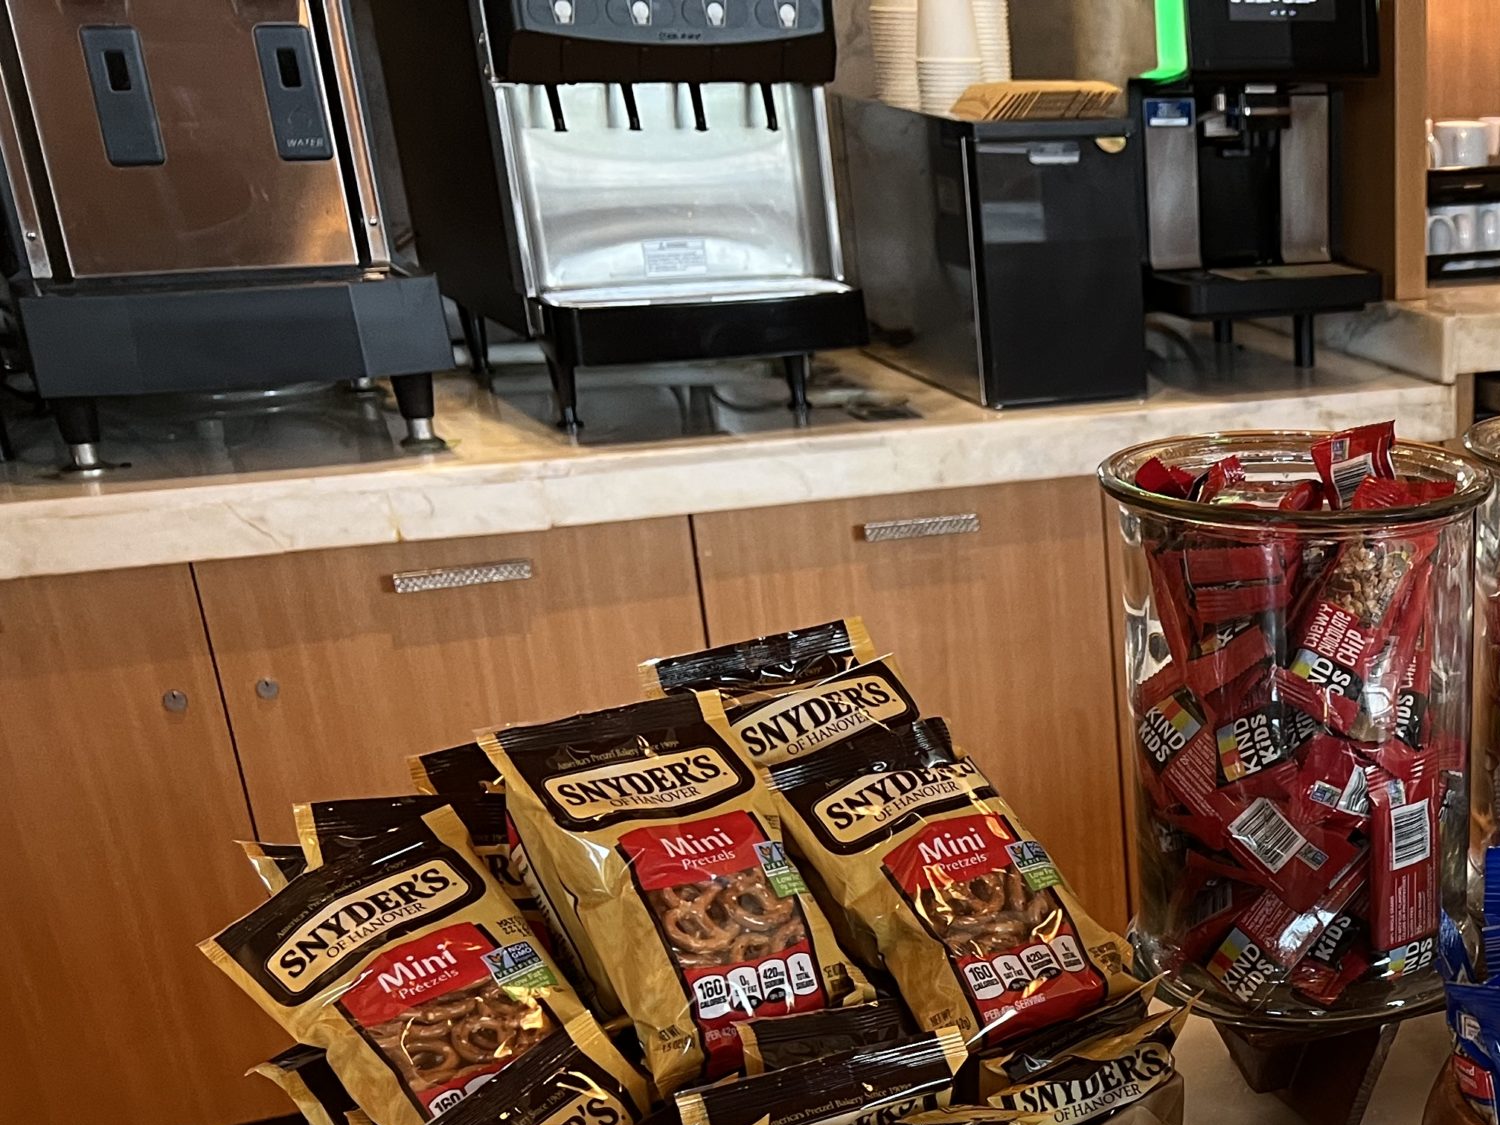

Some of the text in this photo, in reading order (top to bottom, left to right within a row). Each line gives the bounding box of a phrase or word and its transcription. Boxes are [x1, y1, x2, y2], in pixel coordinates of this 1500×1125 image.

[287, 138, 324, 147] WATER
[1306, 657, 1334, 685] ND
[740, 681, 889, 756] SNYDER'S
[786, 711, 871, 755] OF HANOVER
[1145, 706, 1185, 751] KIND
[1232, 717, 1262, 774] KIND
[557, 754, 720, 806] SNYDER'S
[610, 786, 700, 807] OF HANOVER
[896, 782, 959, 810] HANOVER
[660, 827, 734, 858] Mini
[918, 827, 986, 864] Mini
[681, 850, 736, 871] Pretzels
[938, 853, 987, 873] Pretzels
[279, 868, 450, 978] SNYDER'S
[326, 902, 427, 958] OF HANOVER
[377, 944, 457, 993] Mini
[511, 948, 532, 959] GMO
[1222, 942, 1261, 992] KIND
[398, 969, 459, 999] Pretzels
[969, 964, 992, 982] 160
[698, 979, 723, 999] 160
[1015, 993, 1046, 1011] SERVING
[704, 1030, 720, 1042] PER
[805, 1103, 834, 1117] Pretzel
[1054, 1084, 1142, 1123] OF HANOVER
